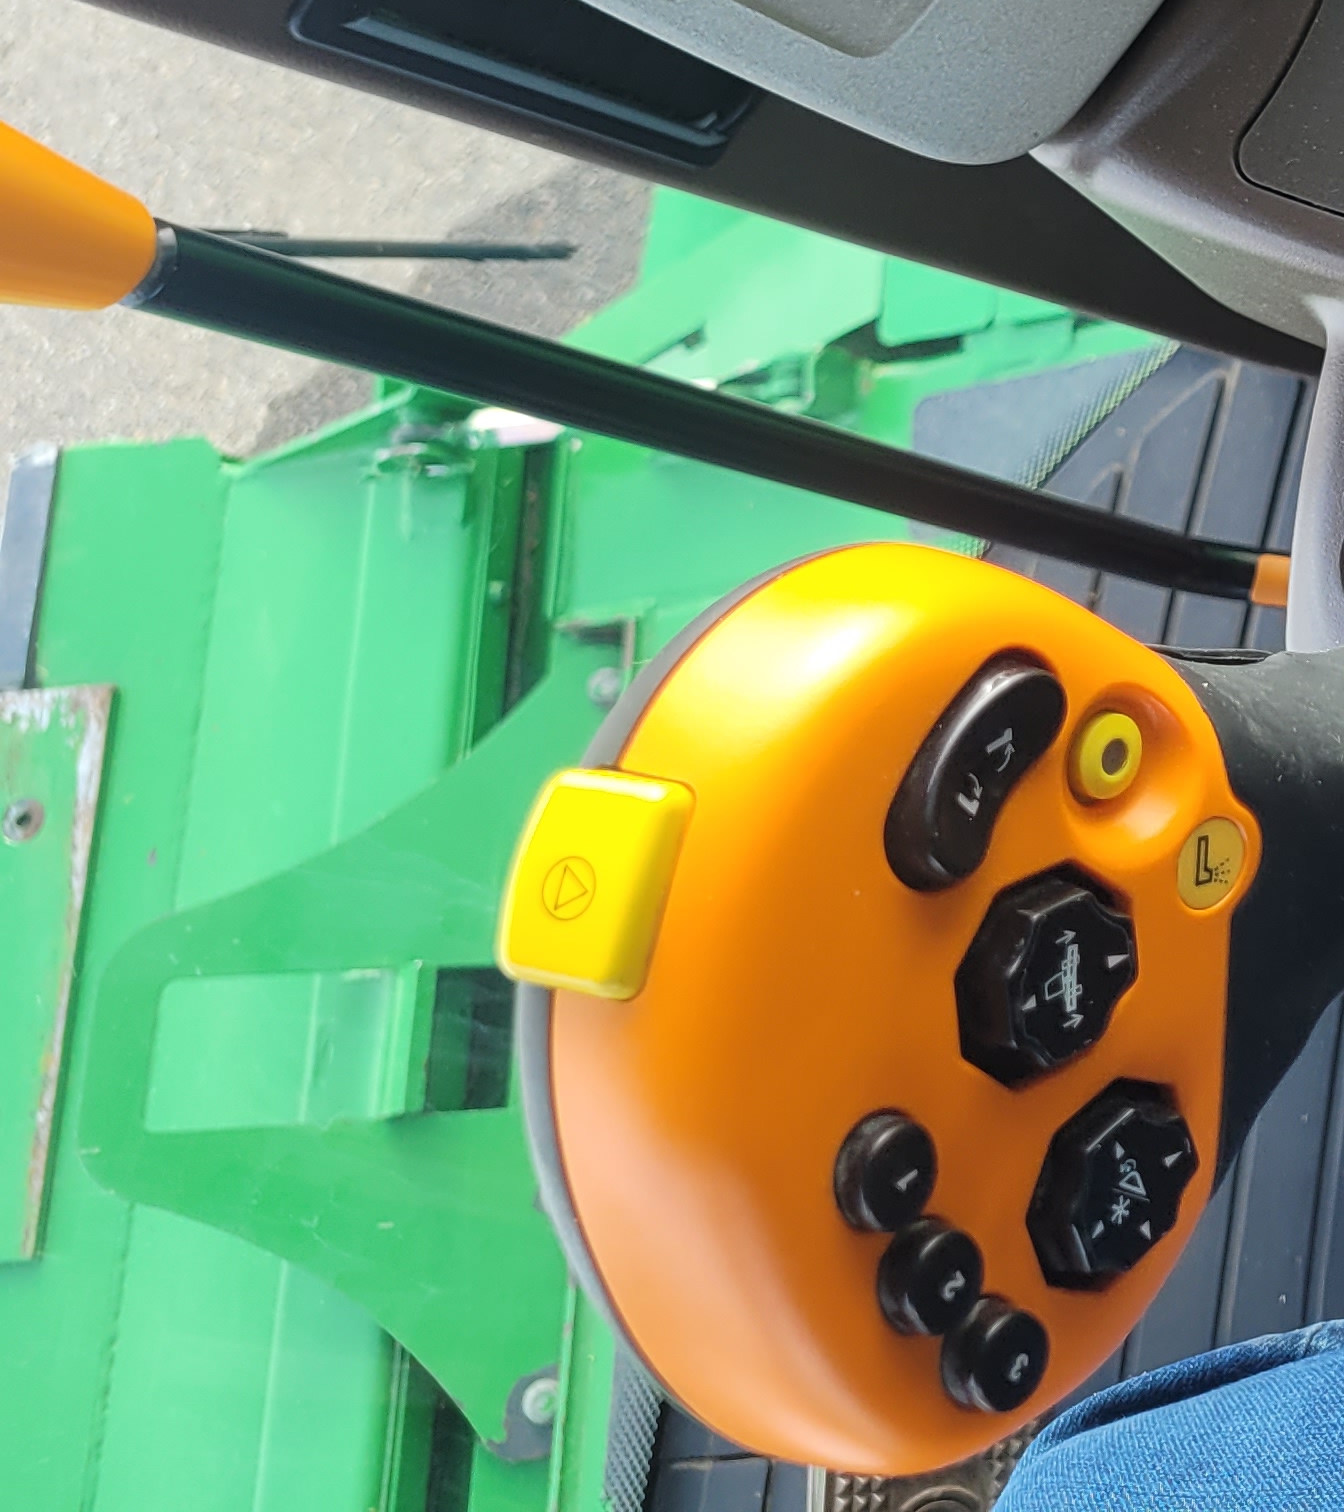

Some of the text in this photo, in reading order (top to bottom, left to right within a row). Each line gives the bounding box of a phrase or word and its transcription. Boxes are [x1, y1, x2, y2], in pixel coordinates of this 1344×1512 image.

[897, 1168, 918, 1192] 1
[942, 1270, 966, 1300] 2
[1008, 1352, 1030, 1383] 3
